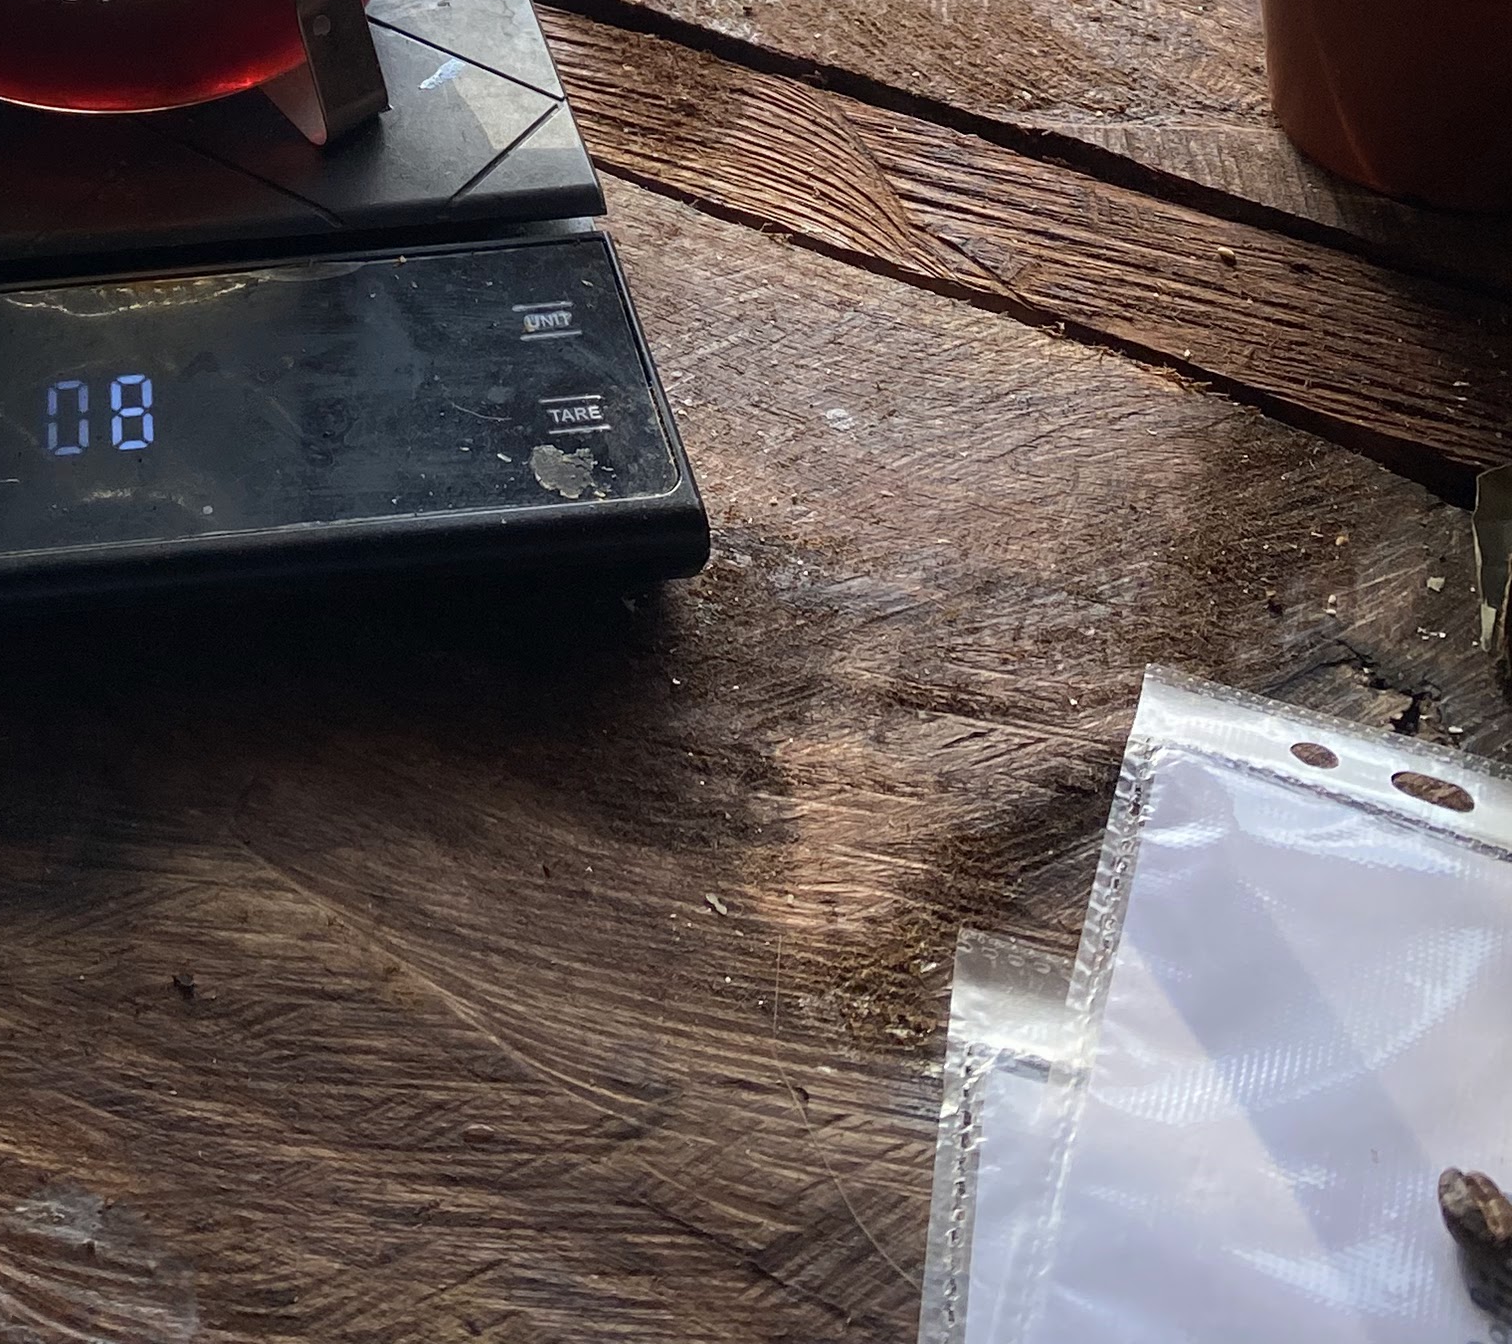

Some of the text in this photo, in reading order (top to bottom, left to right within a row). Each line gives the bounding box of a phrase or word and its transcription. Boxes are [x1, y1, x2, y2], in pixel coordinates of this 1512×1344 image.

[525, 311, 573, 330] UNIT
[47, 374, 154, 456] 08
[547, 405, 603, 423] TARE
